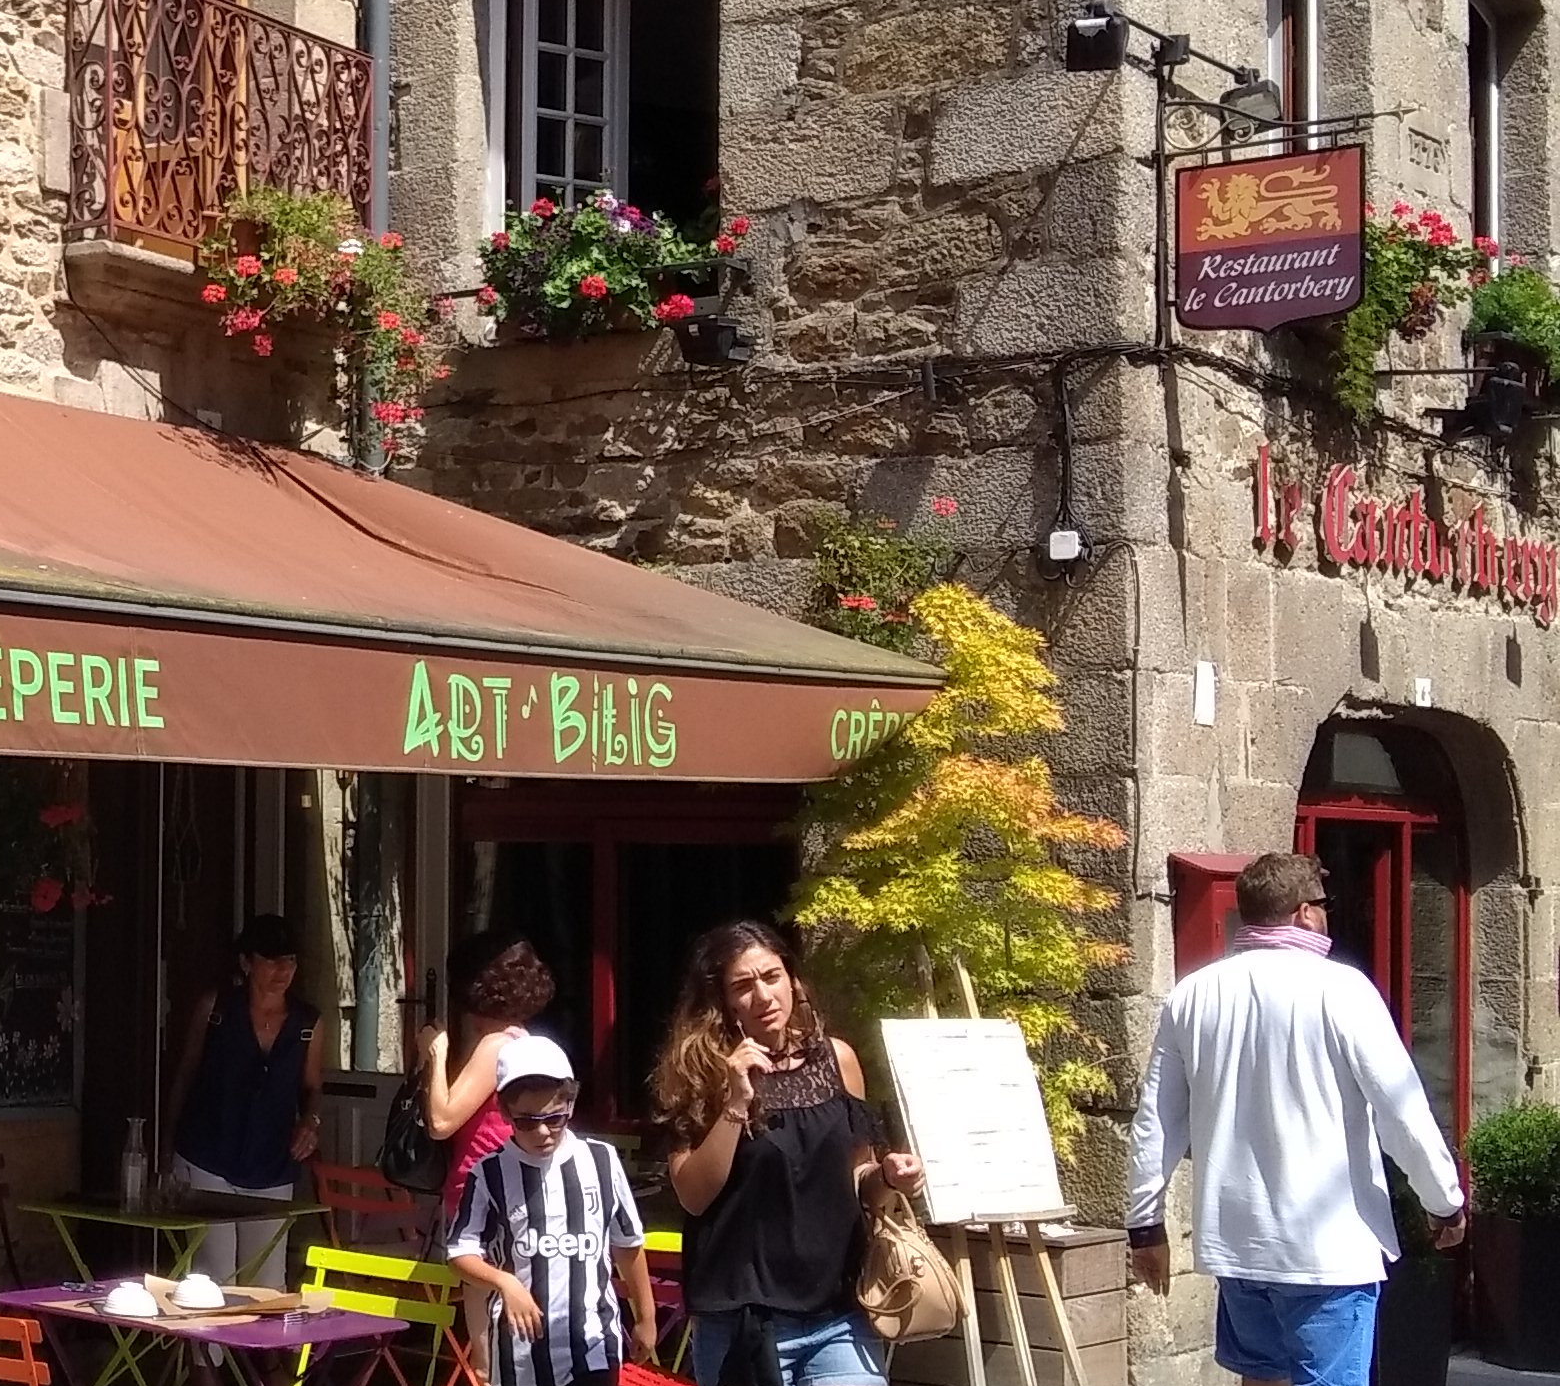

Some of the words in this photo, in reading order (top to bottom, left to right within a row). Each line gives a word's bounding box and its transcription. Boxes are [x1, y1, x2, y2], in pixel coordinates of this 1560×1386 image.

[1197, 243, 1342, 281] Restaurant
[1184, 288, 1207, 312] le
[1213, 274, 1355, 308] Cantorbery
[515, 1228, 598, 1261] Jeep
